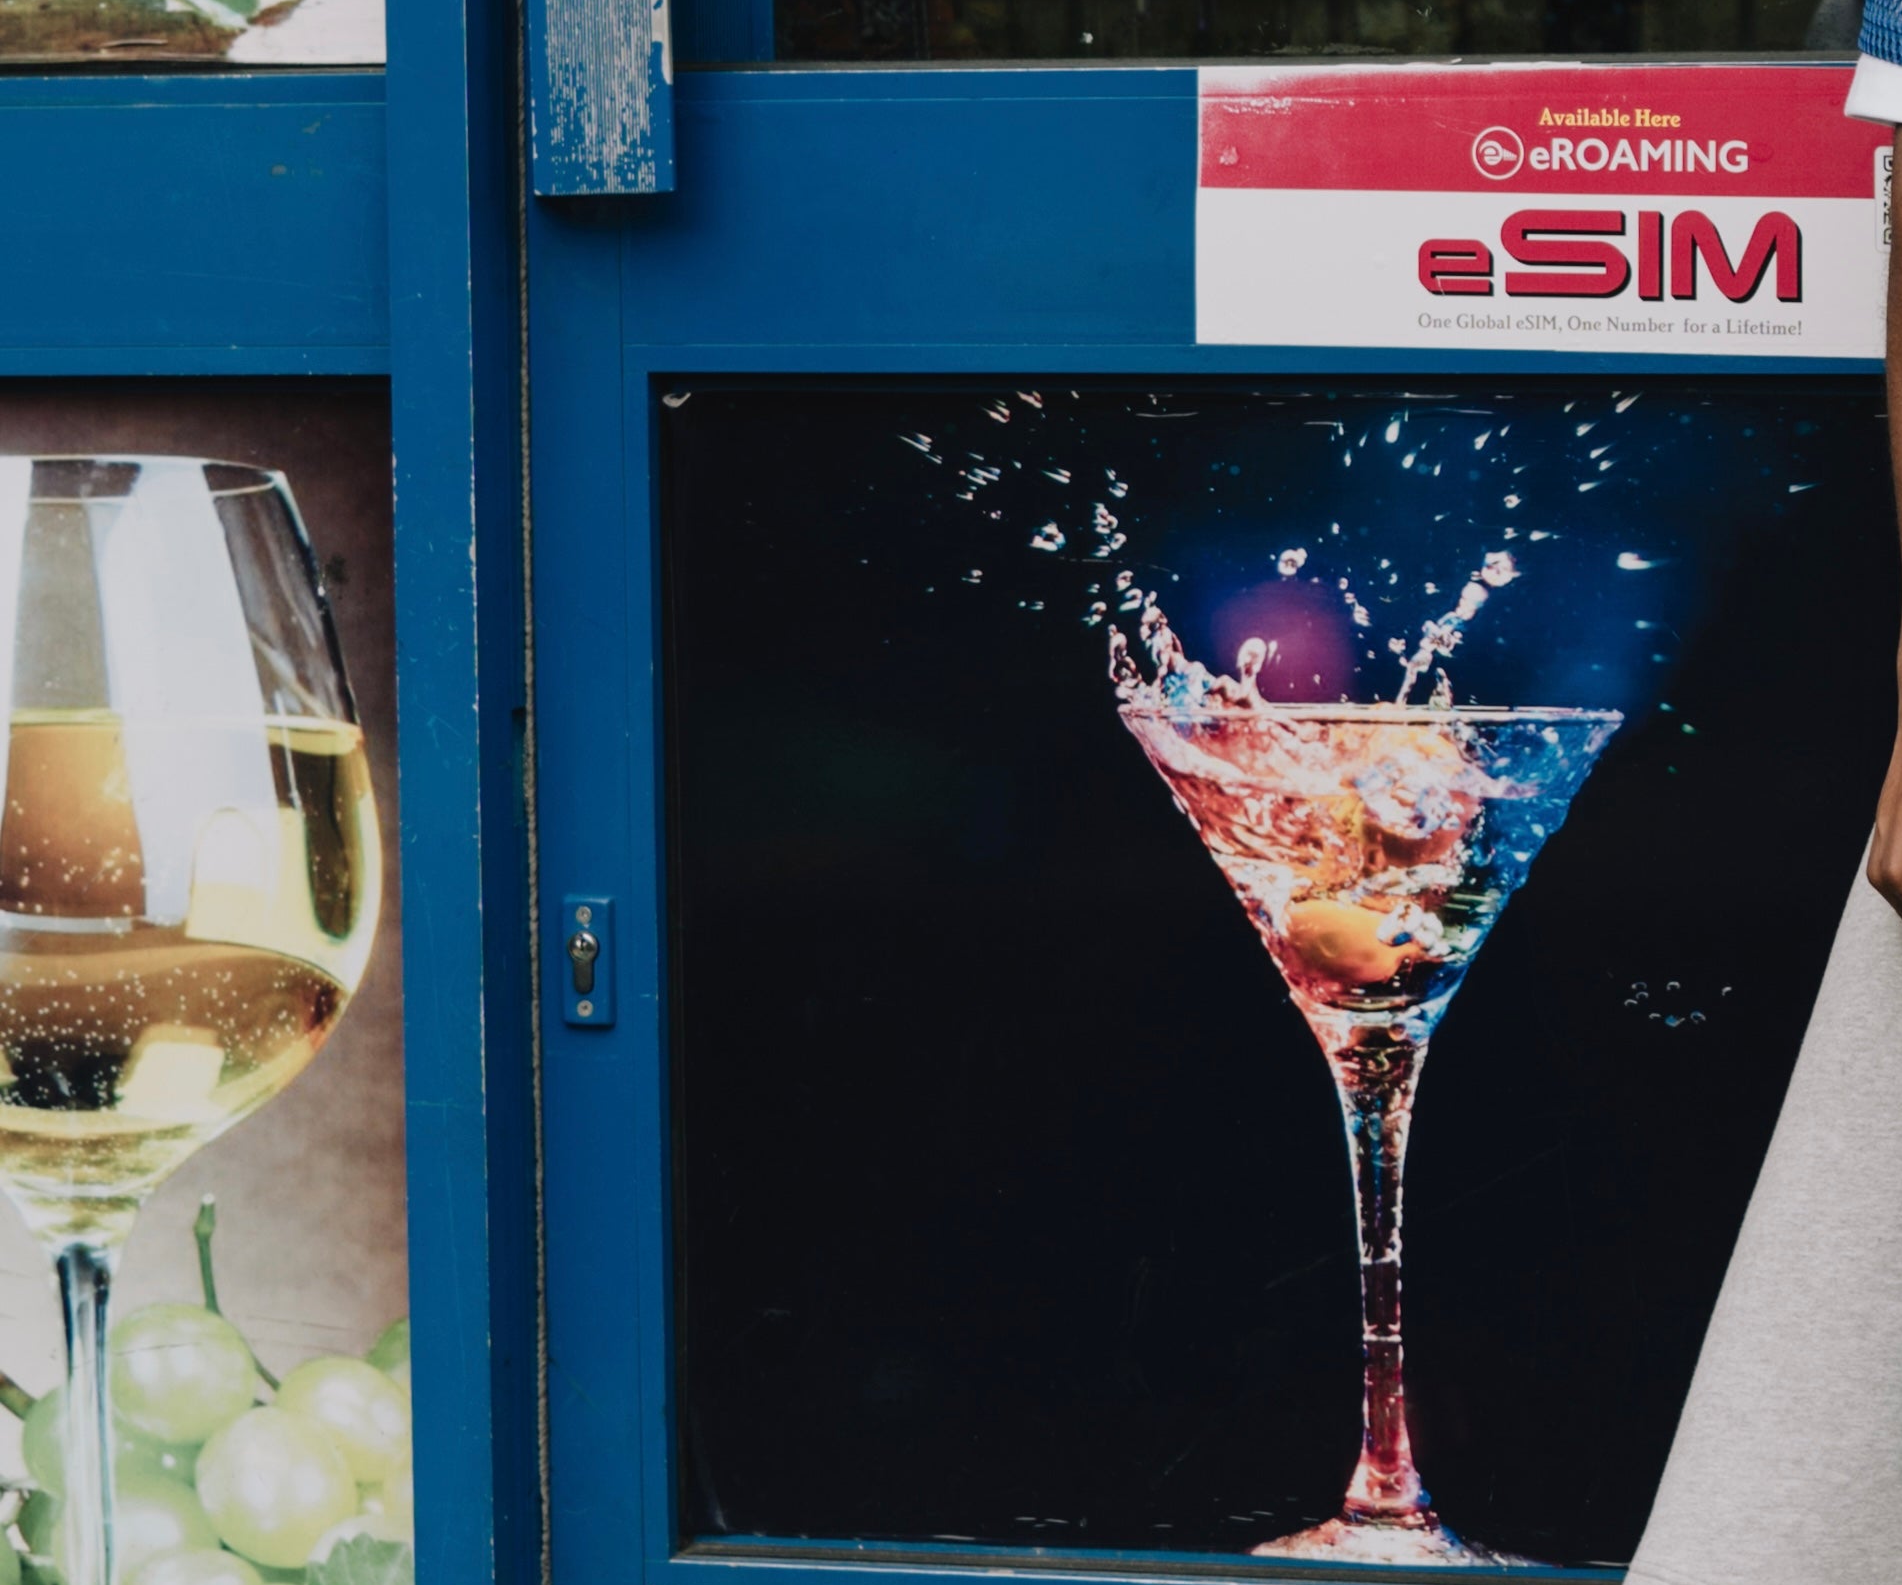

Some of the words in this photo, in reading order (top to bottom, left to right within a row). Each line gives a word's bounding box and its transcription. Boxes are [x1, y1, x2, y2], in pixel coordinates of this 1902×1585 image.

[1539, 108, 1630, 127] Available
[1635, 109, 1681, 128] Here
[1529, 137, 1749, 174] eROAMING
[1418, 209, 1803, 303] eSIM
[1418, 313, 1453, 330] One
[1456, 313, 1511, 331] Global
[1515, 315, 1563, 334] eSIM,
[1567, 316, 1601, 332] One
[1606, 316, 1674, 334] Number
[1683, 318, 1707, 335] for
[1711, 324, 1721, 335] a
[1725, 318, 1802, 336] Lifetime!
